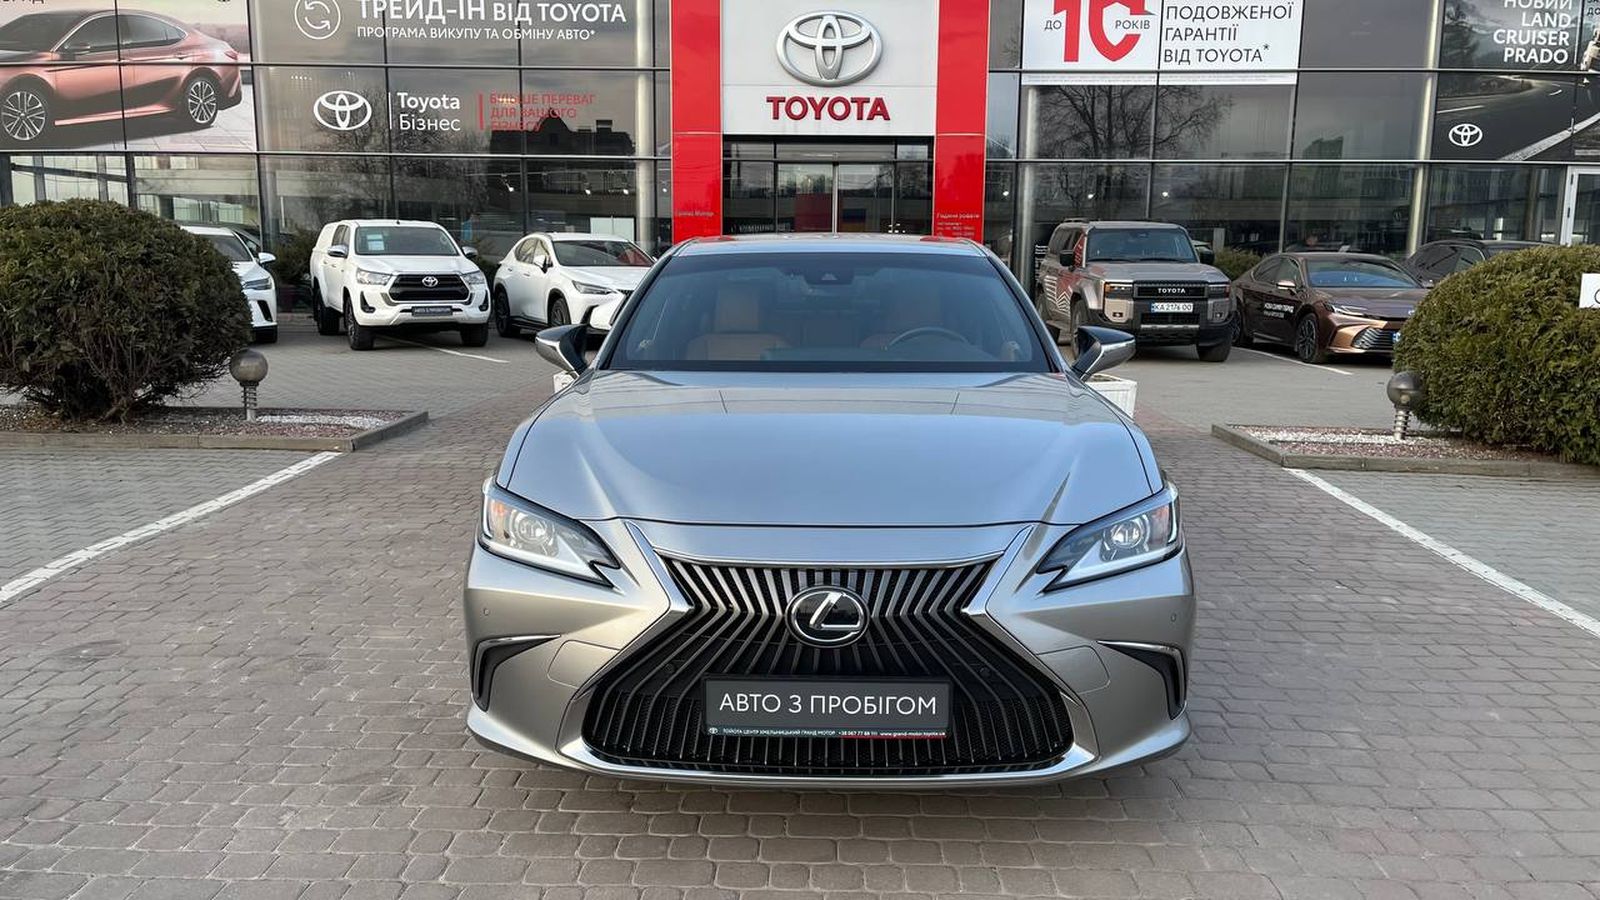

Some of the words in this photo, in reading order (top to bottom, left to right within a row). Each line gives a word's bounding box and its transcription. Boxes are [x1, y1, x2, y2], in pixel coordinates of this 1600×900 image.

[493, 2, 532, 26] ВІД
[537, 3, 627, 22] TOYOTA
[1166, 2, 1294, 22] ПОДОВЖЕНОЇ
[1521, 12, 1572, 28] LAND
[357, 26, 427, 39] ПРОГРАМА
[430, 27, 482, 40] ВИКУПУ
[484, 28, 500, 39] ТА
[502, 28, 554, 40] ОБМІНУ
[1045, 19, 1063, 30] ДО
[1115, 19, 1151, 30] РОКІВ
[1165, 23, 1240, 41] ГАРАНТІЇ
[1493, 28, 1570, 46] CRUISER
[1163, 48, 1191, 66] ВІД
[1503, 46, 1569, 64] PRADO
[397, 91, 461, 113] Toyota
[766, 95, 891, 121] TOYOTA
[399, 113, 461, 132] Бізнес
[719, 693, 781, 713] АВТО
[788, 695, 802, 714] З
[810, 695, 937, 715] ПРОБІГОМ
